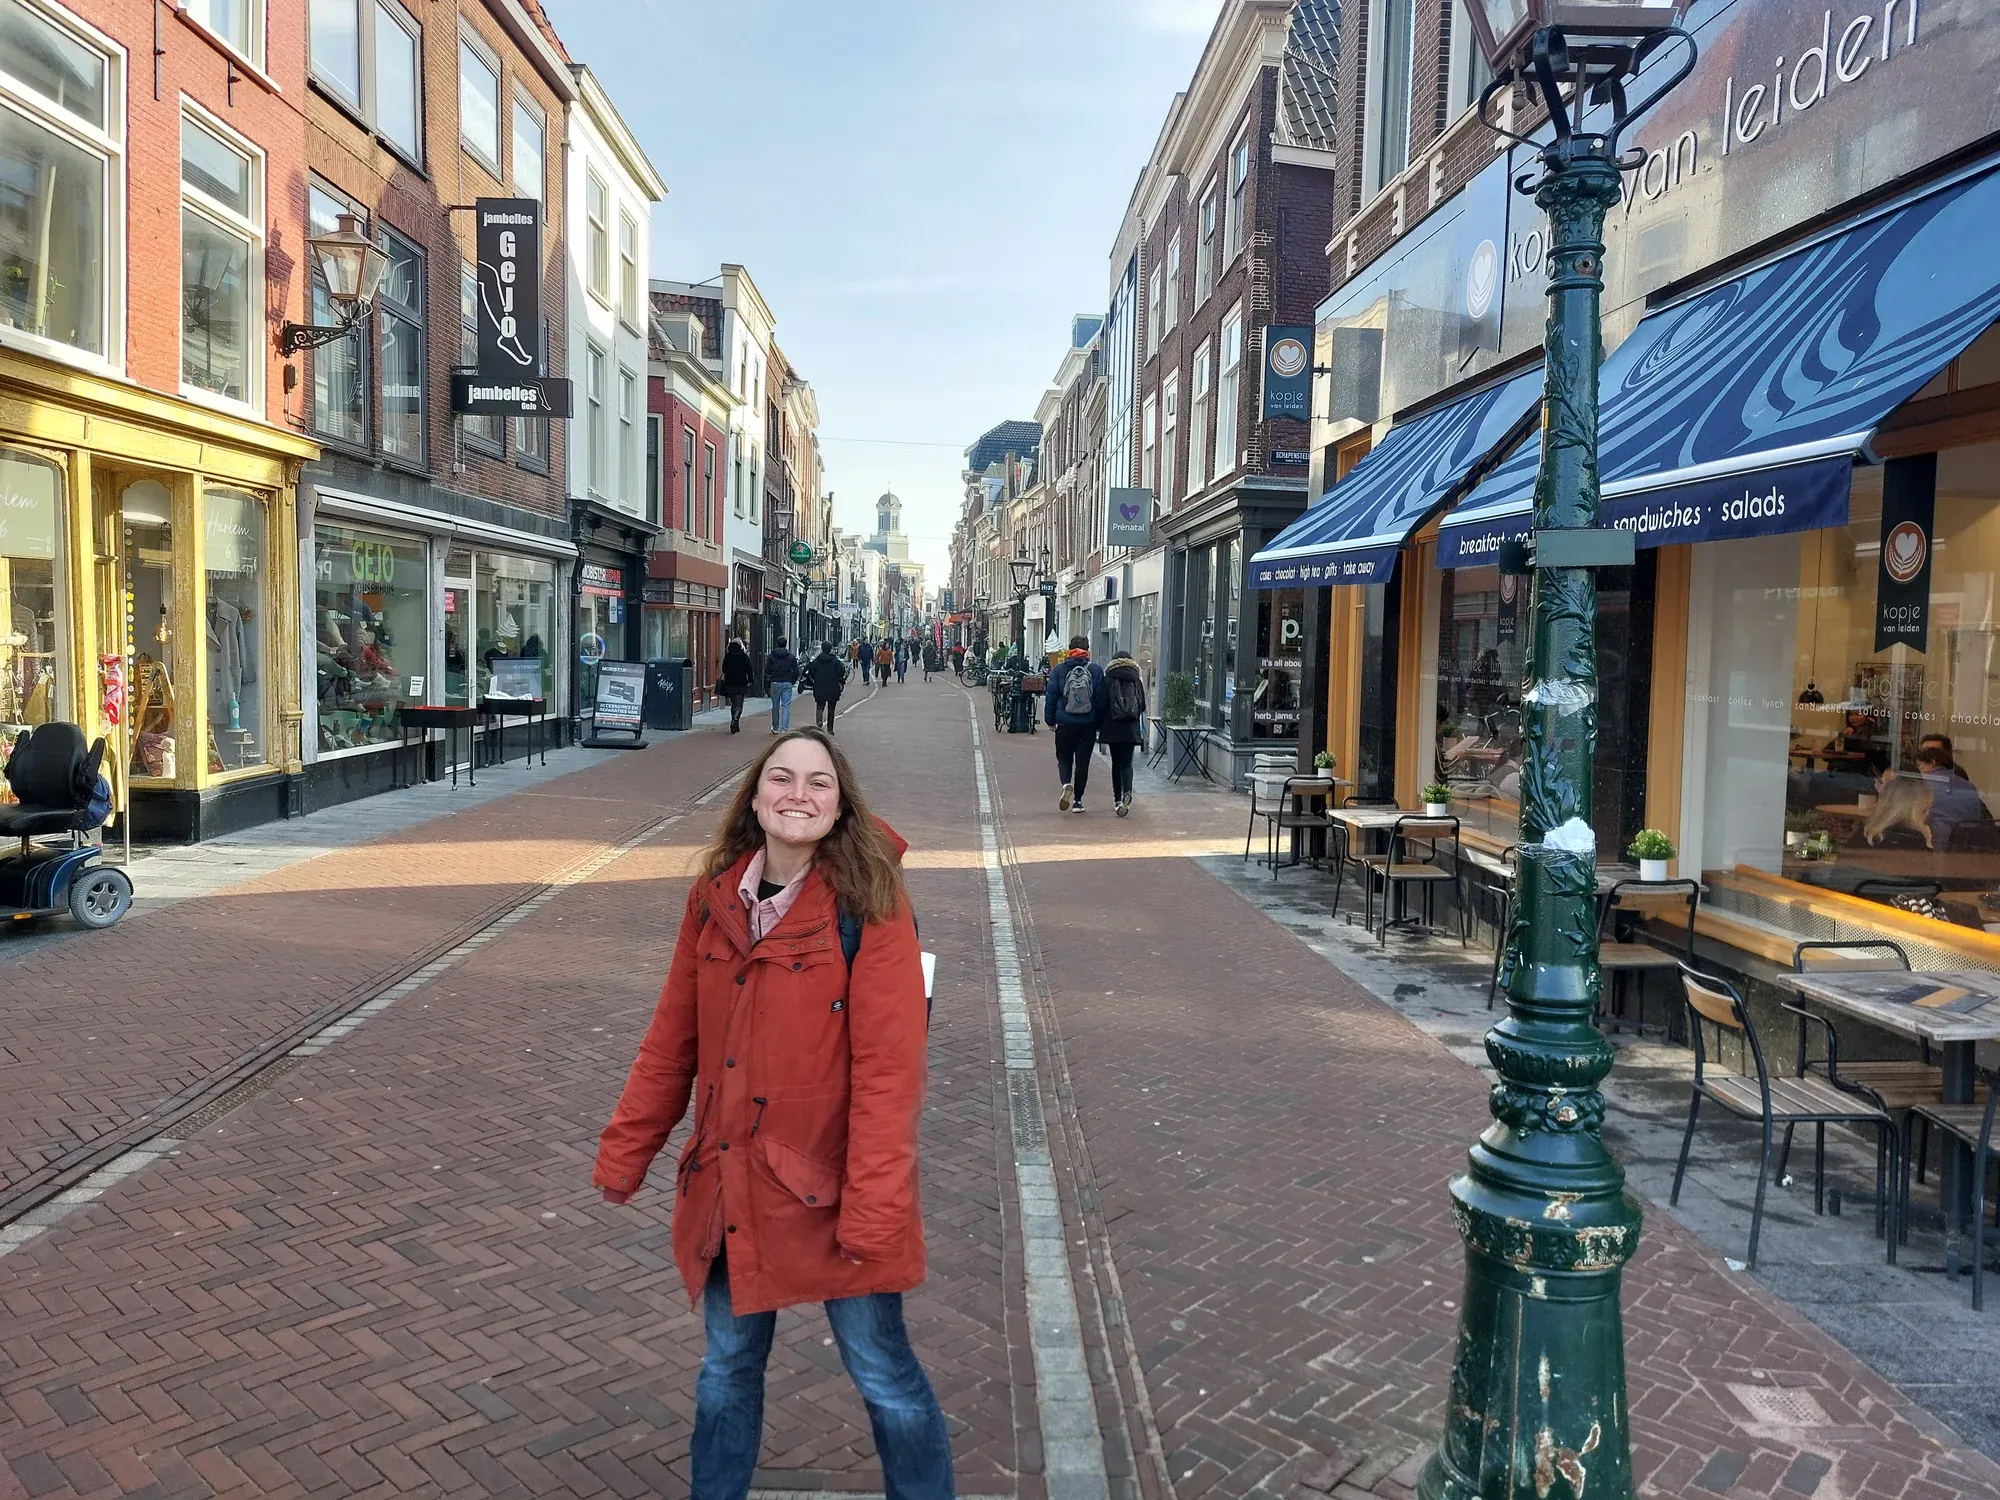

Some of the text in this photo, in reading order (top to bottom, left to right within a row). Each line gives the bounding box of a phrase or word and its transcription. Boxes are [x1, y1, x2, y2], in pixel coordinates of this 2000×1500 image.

[1620, 130, 1698, 216] van
[1721, 0, 1918, 156] leiden
[483, 212, 533, 227] jambelles
[467, 384, 537, 404] jambelles
[1269, 390, 1304, 404] kopje
[1283, 401, 1304, 409] leiden
[1613, 485, 1786, 533] sandwiches salads
[1112, 522, 1146, 532] Prénatal
[1458, 531, 1505, 555] breakfast
[351, 539, 395, 583] GEJO
[1259, 560, 1376, 581] cakes chocolat high tea gifts take away
[1882, 603, 1921, 624] kopje
[1882, 622, 1920, 633] van leiden
[1728, 694, 1753, 706] coffee
[1762, 695, 1784, 709] lunch
[1858, 705, 1892, 718] salads
[1904, 709, 1936, 722] cakes
